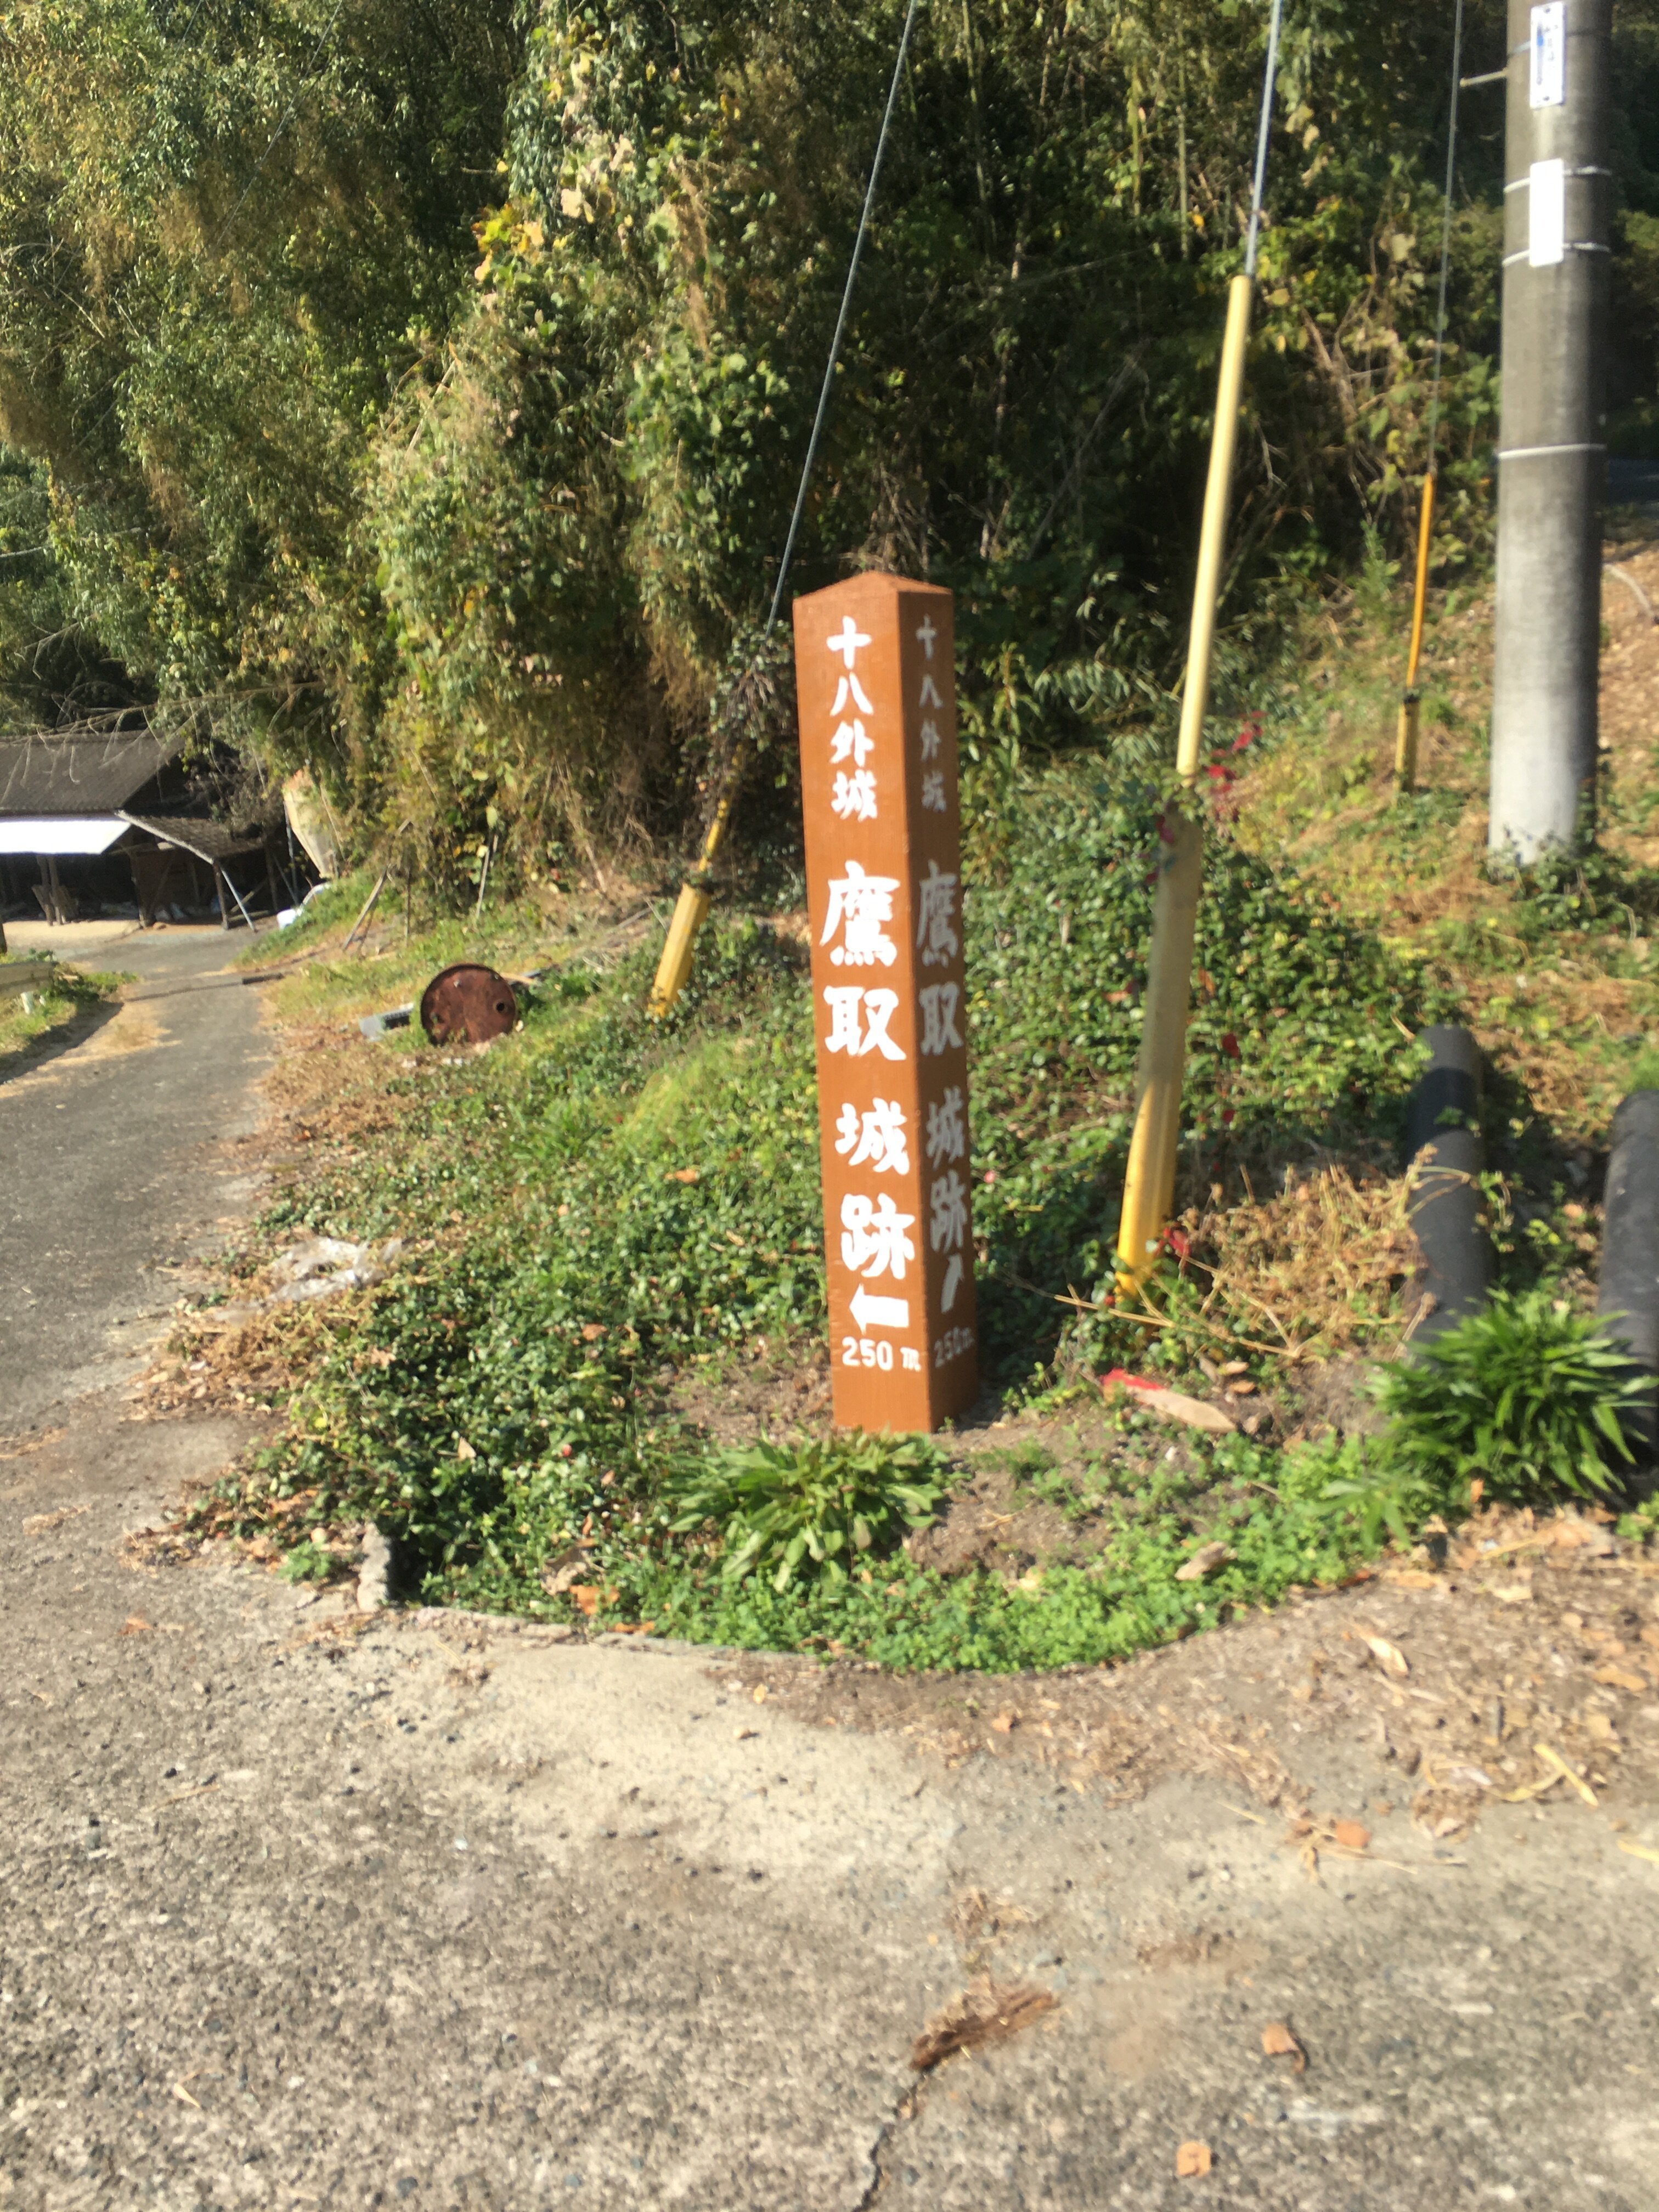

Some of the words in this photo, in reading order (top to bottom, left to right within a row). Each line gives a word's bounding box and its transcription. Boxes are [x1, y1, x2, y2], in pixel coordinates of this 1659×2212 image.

[826, 615, 878, 822] 十八外城
[819, 859, 916, 1280] 鷹取城跡
